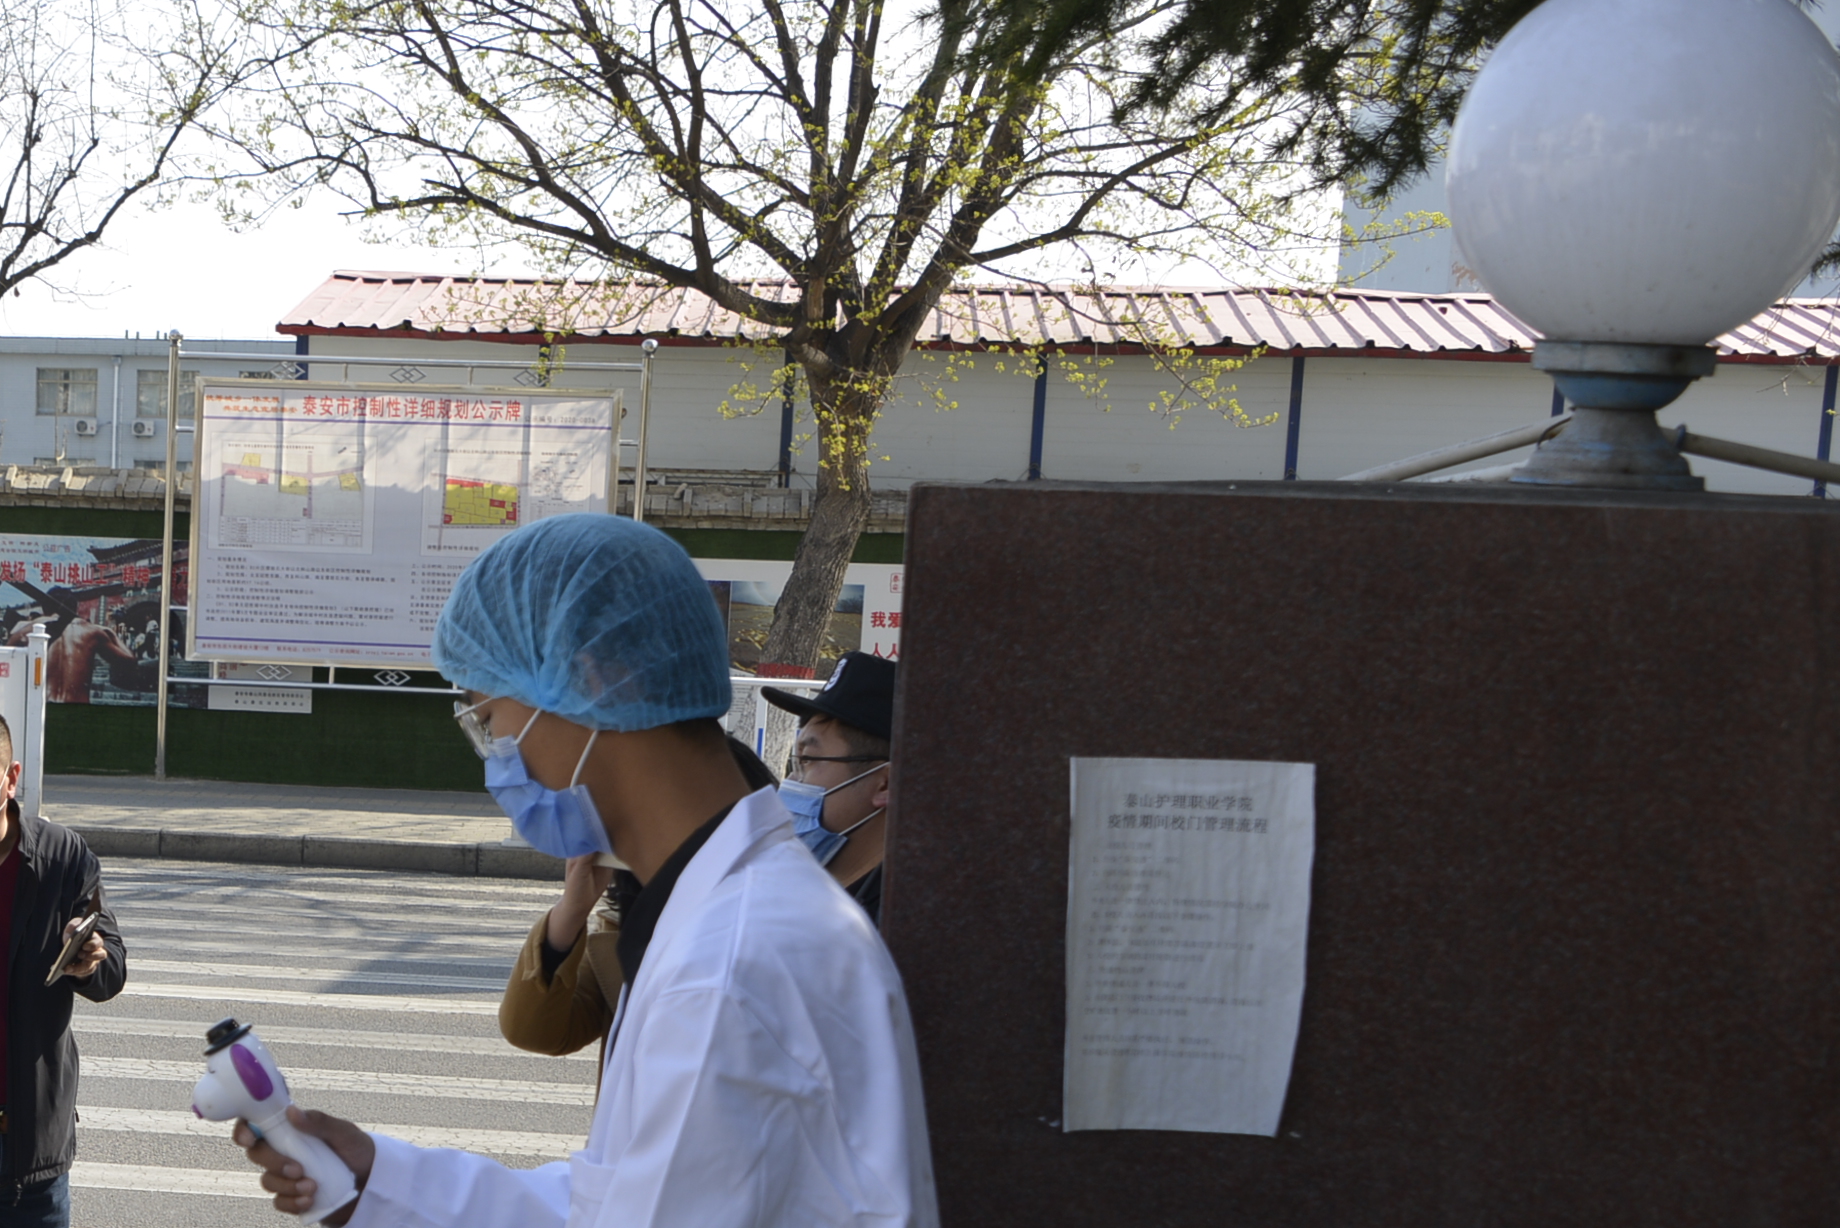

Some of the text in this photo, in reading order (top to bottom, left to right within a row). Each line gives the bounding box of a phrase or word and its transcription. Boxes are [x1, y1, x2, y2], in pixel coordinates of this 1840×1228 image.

[303, 395, 522, 421] 泰安市控制性详细规划公示牌
[1123, 794, 1253, 811] 泰山护理职业学院
[1107, 814, 1269, 834] 疫情期间校门管理流程
